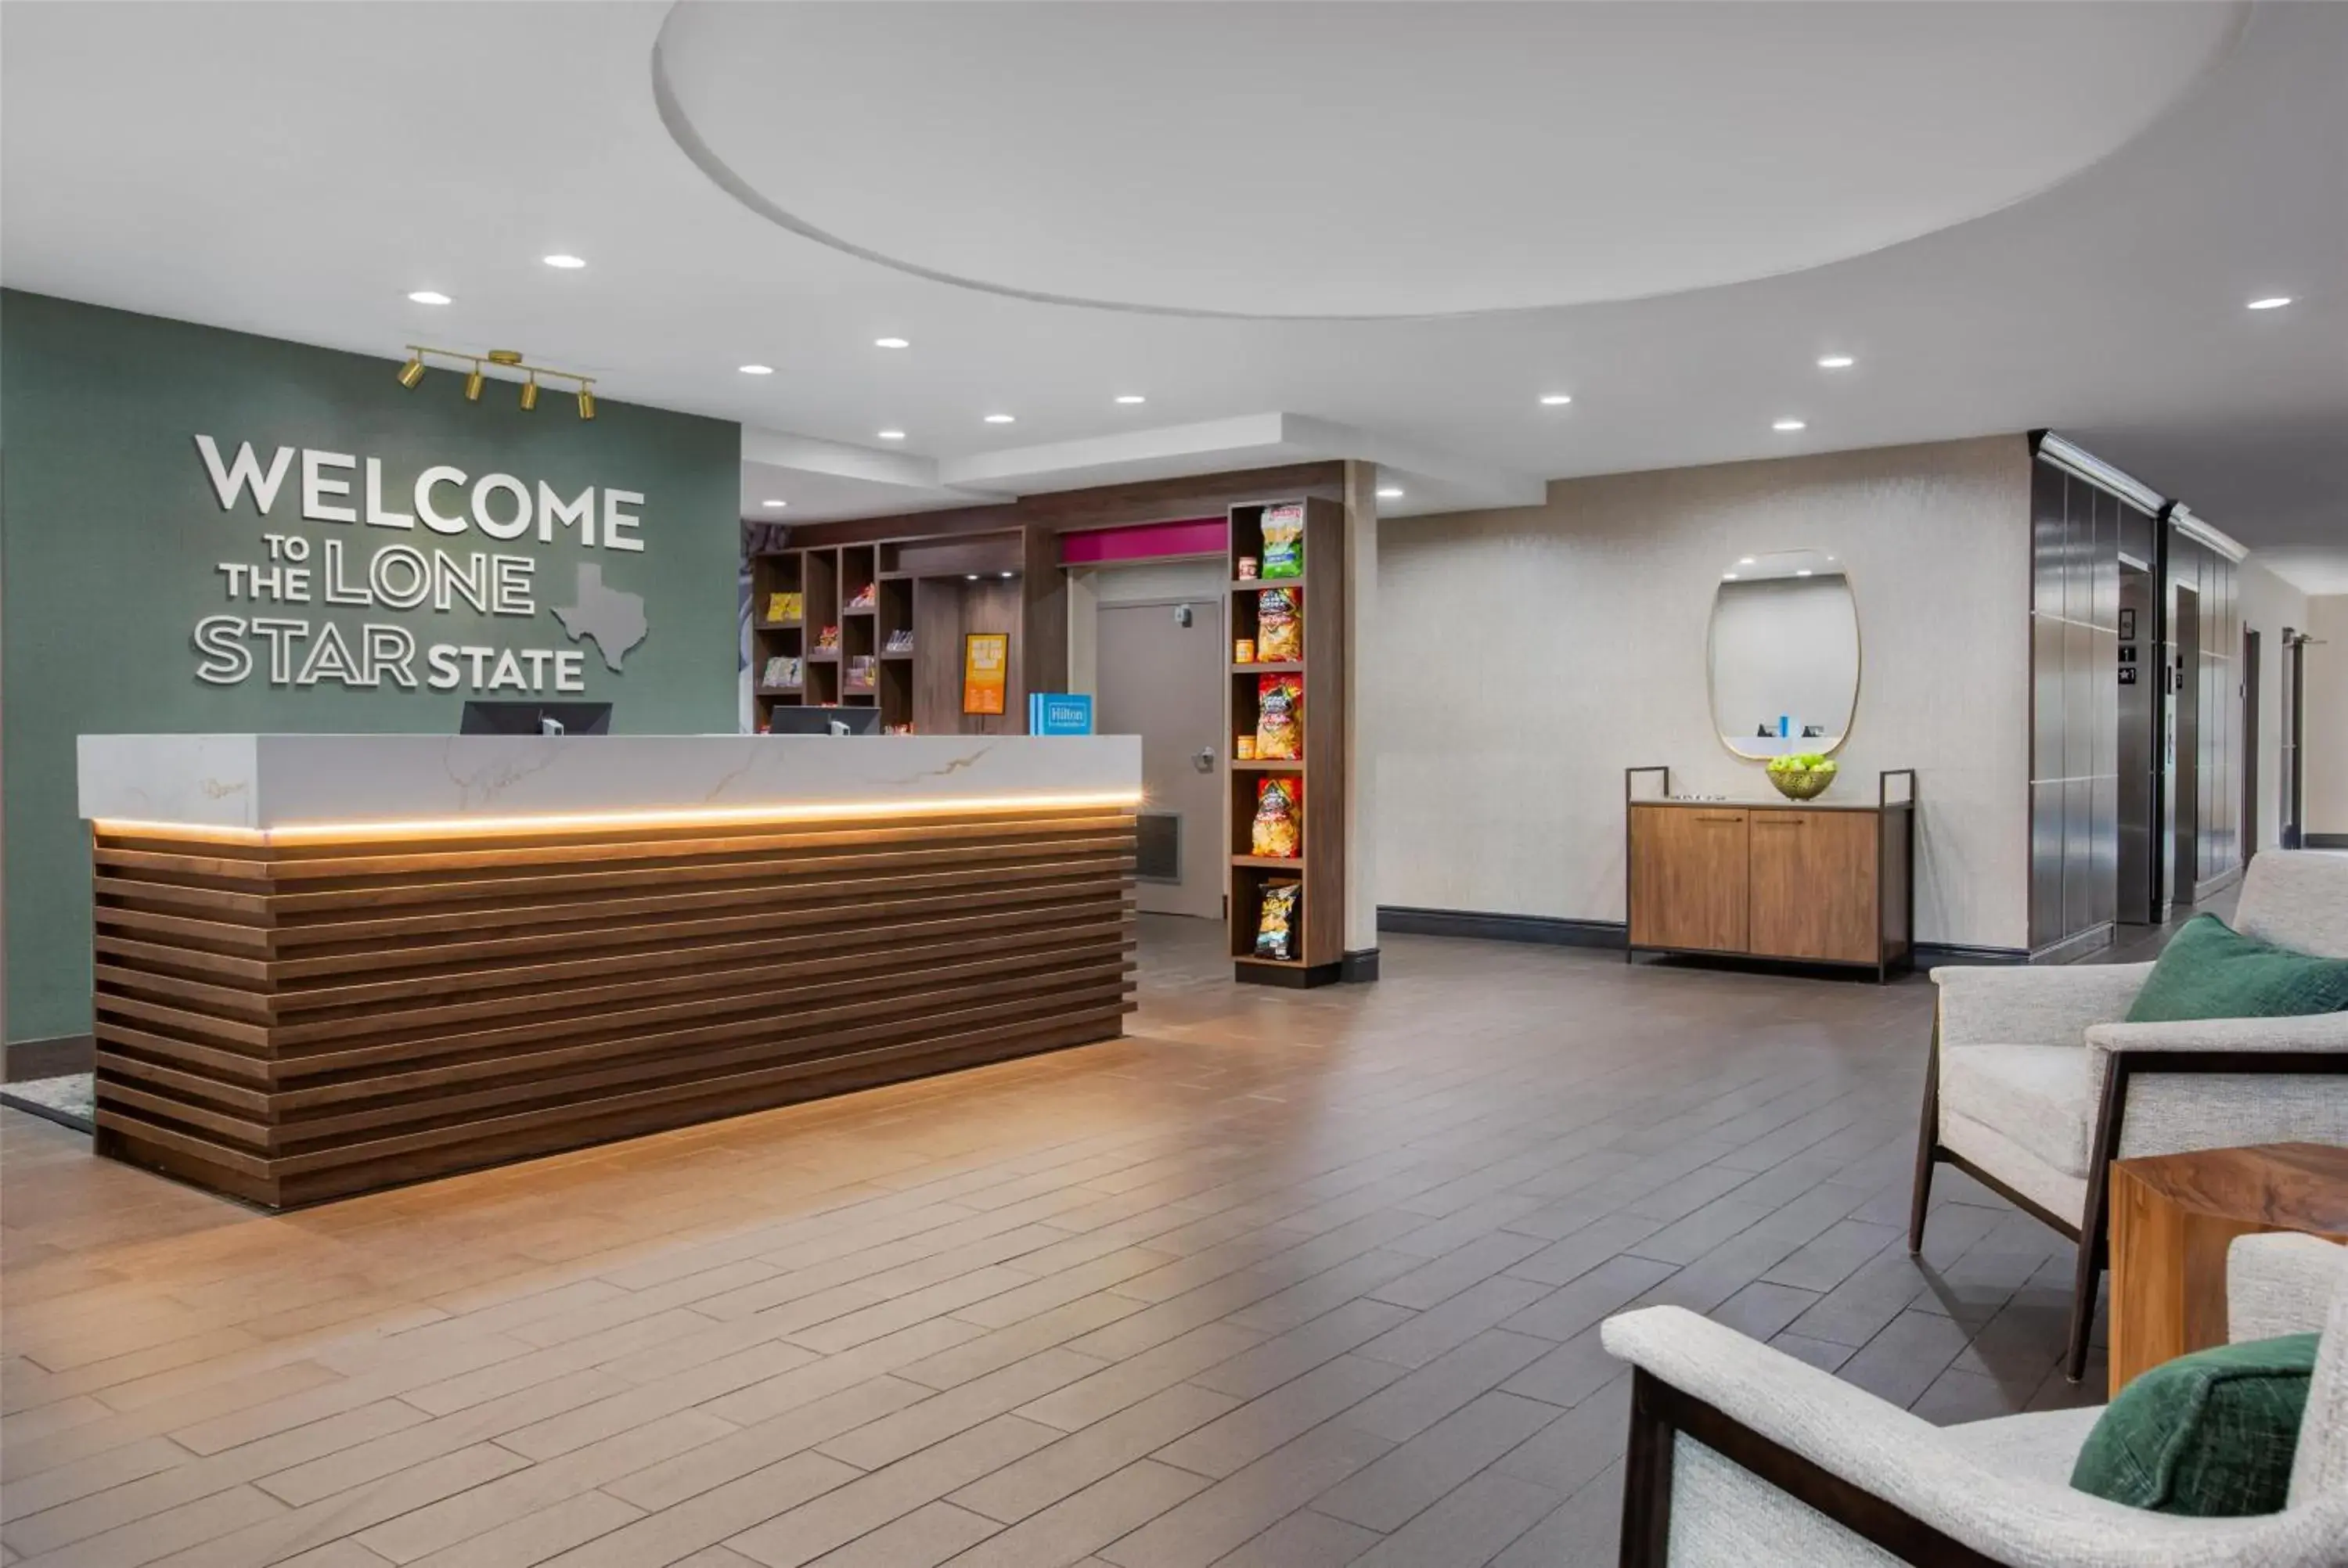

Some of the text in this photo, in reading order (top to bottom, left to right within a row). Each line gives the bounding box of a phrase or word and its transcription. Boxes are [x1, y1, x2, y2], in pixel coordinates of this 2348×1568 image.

[194, 433, 646, 552] WELCOME
[217, 539, 536, 615] THE LONE
[263, 534, 310, 562] TO
[193, 615, 585, 692] STAR STATE
[1051, 707, 1083, 721] Hilton
